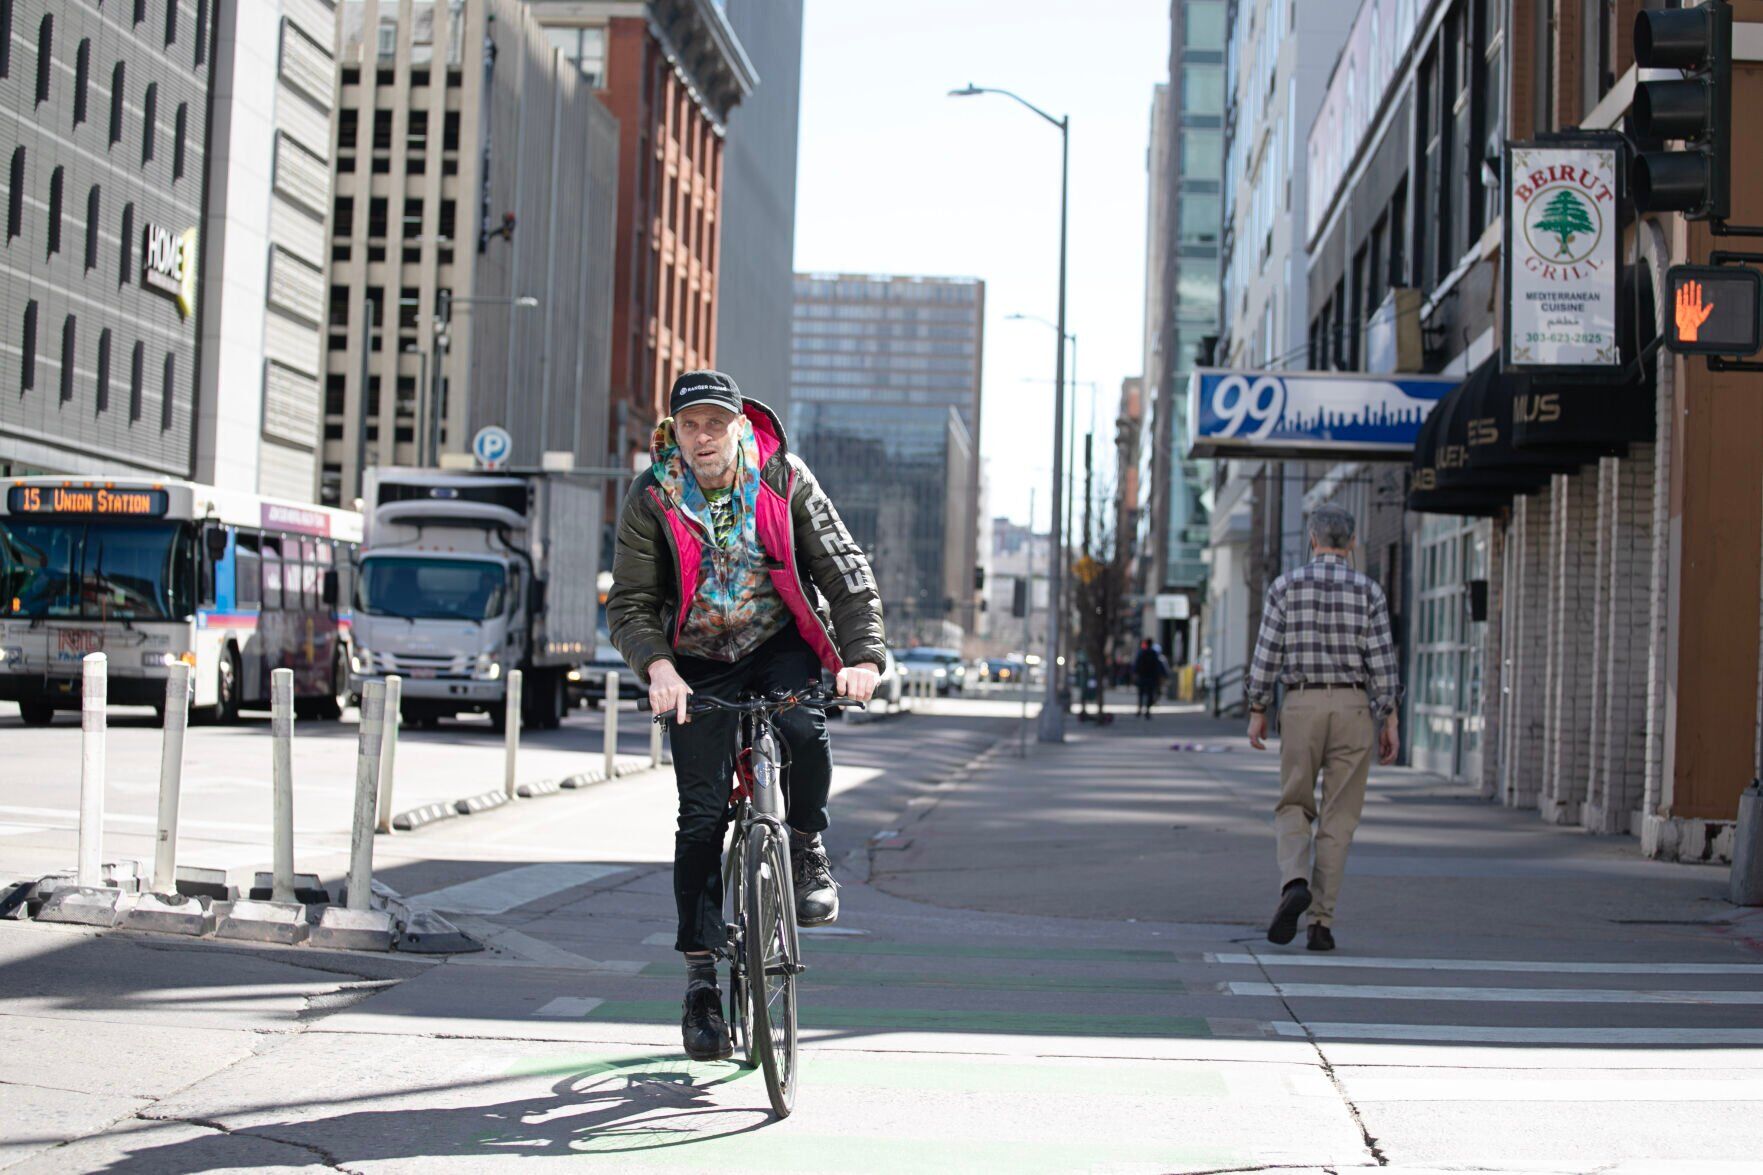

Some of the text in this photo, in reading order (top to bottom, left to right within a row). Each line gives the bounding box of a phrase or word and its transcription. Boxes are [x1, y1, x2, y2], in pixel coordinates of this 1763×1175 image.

[1515, 164, 1613, 203] BEIRUT
[147, 222, 184, 281] HOME
[1525, 256, 1604, 281] GRILL
[1526, 292, 1600, 301] MEDITERRANEAN
[1541, 303, 1584, 312] CUISINE
[1210, 375, 1285, 441] 99
[23, 488, 41, 511] 15
